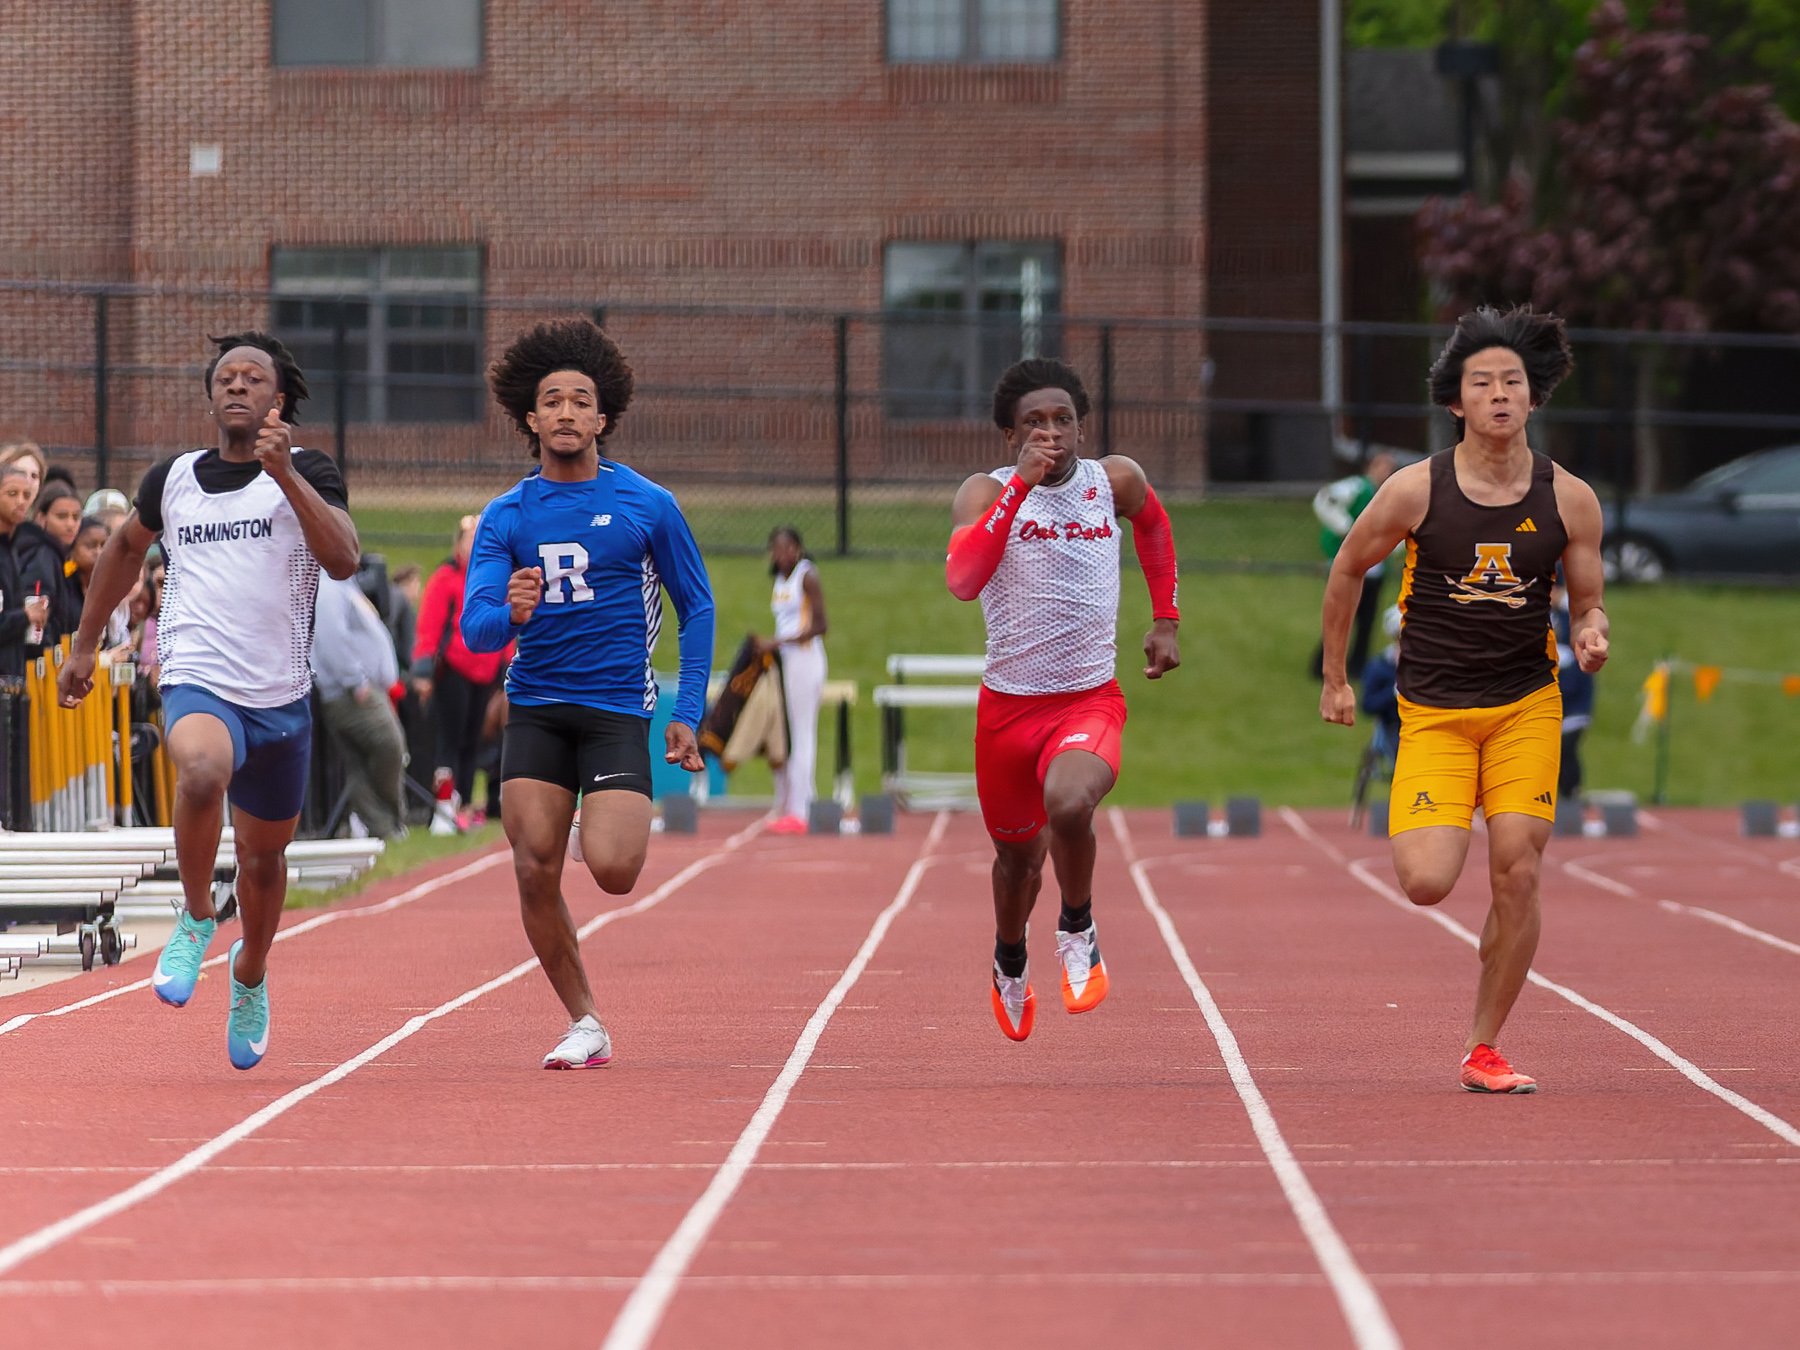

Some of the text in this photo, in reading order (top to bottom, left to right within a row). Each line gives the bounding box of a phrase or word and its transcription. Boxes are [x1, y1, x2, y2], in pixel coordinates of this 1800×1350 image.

[177, 518, 272, 546] FARMINGTON
[984, 505, 1006, 534] Park
[1019, 516, 1113, 542] Oak Park
[537, 541, 595, 604] R
[1461, 542, 1522, 585] A
[1412, 791, 1434, 807] A
